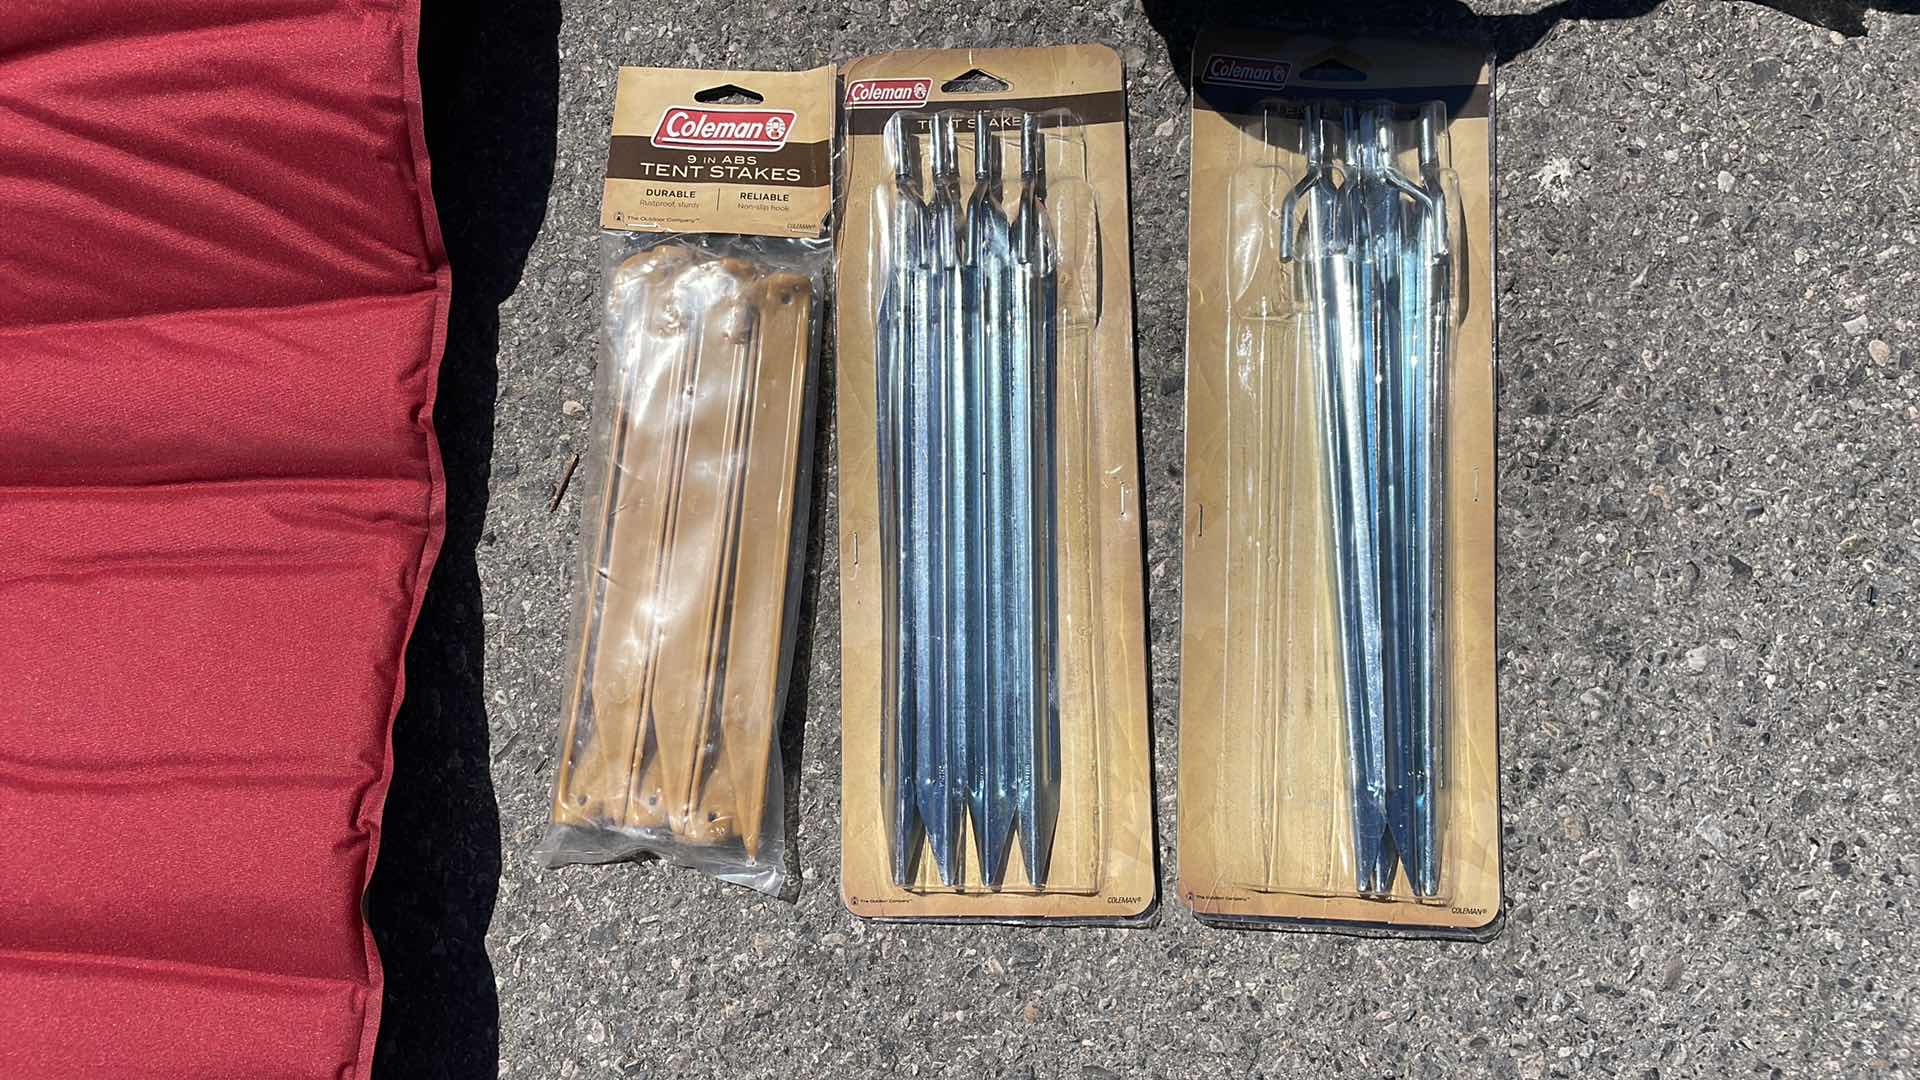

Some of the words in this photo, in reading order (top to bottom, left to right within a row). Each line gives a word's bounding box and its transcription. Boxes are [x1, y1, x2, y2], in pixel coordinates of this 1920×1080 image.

[1210, 58, 1272, 80] Coleman
[851, 82, 912, 100] Coleman
[665, 111, 764, 140] Coleman
[687, 154, 697, 164] 9
[703, 156, 717, 164] IN
[722, 155, 758, 165] ABS
[640, 162, 704, 178] TENT
[710, 166, 801, 182] STAKES
[645, 188, 697, 199] DURABLE
[739, 192, 790, 202] RELIABLE
